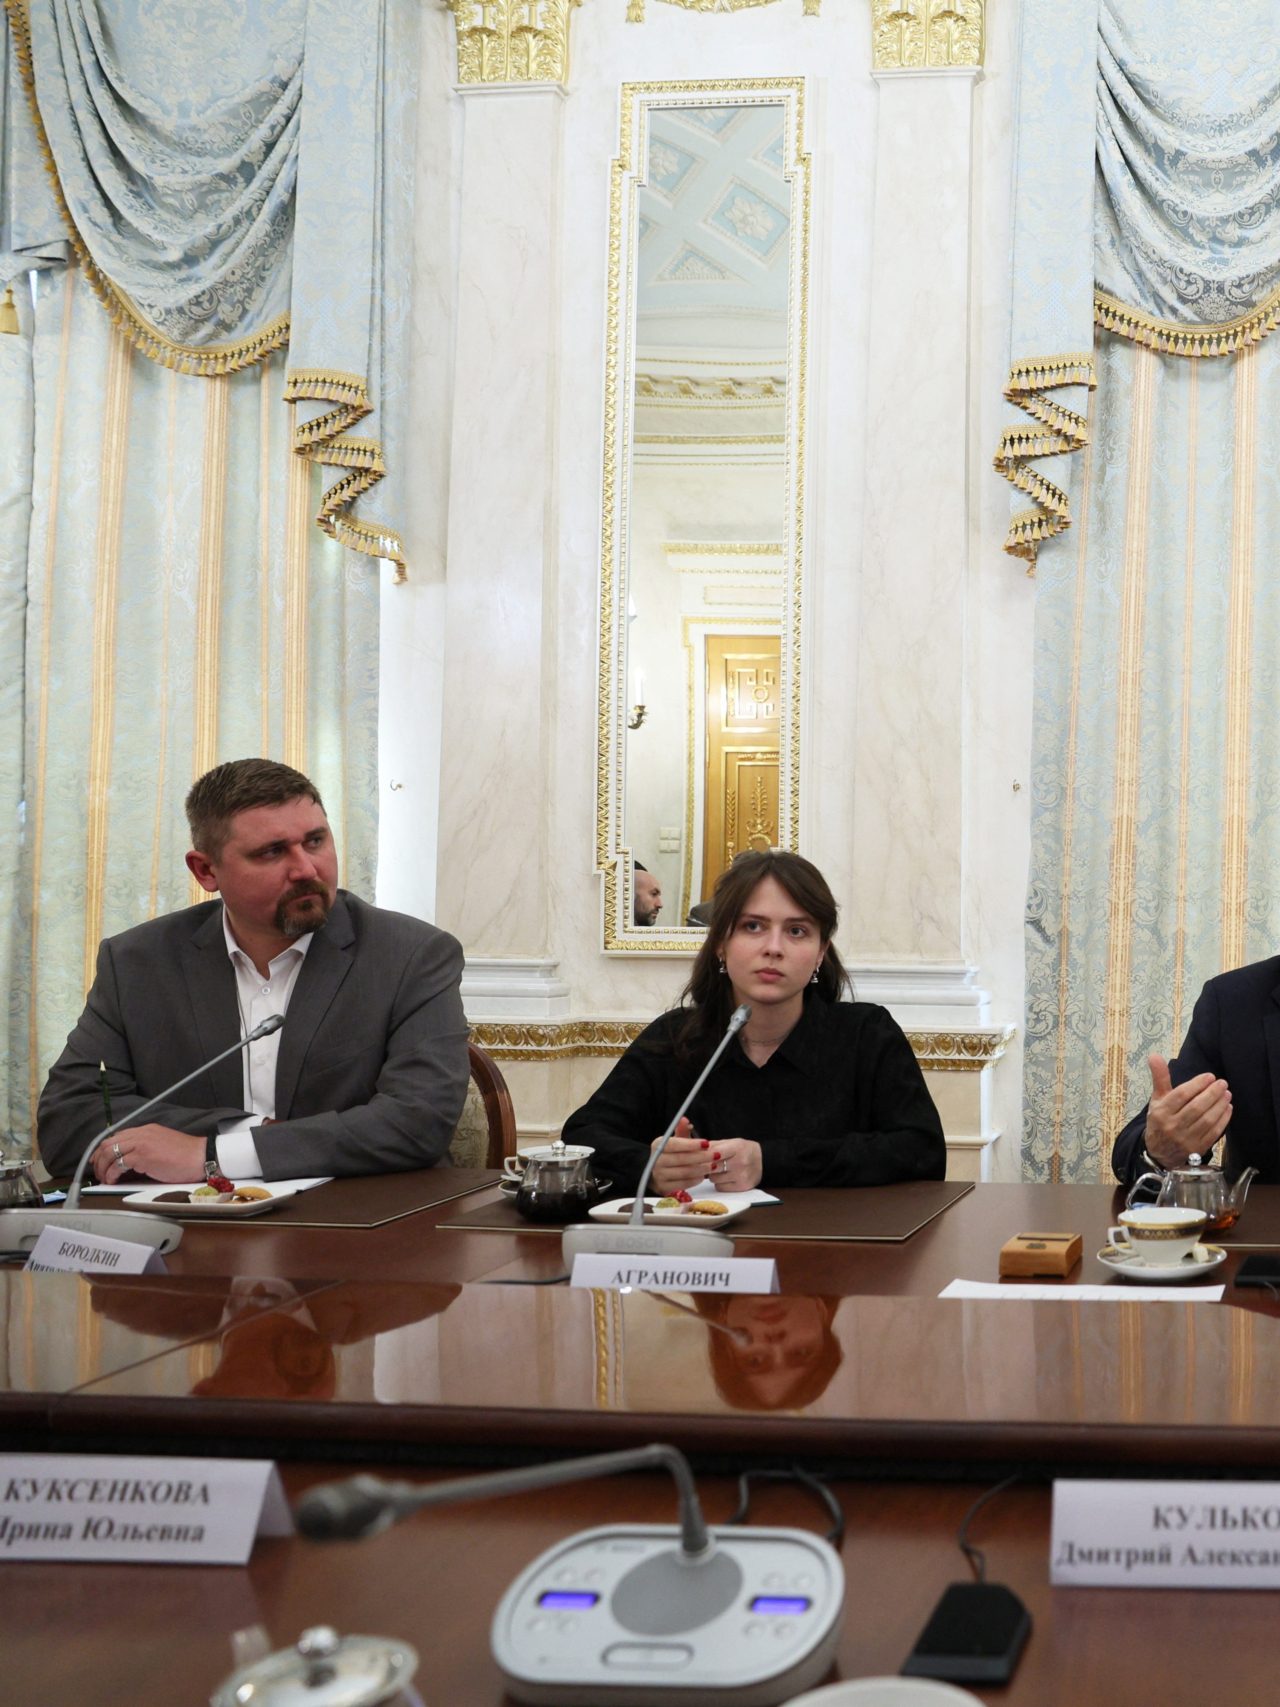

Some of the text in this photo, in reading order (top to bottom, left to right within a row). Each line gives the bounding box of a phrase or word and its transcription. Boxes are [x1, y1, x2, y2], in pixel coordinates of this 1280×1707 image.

[58, 1241, 121, 1268] БОРОДКИН
[611, 1269, 731, 1287] АГРАНОВИЧ
[4, 1477, 210, 1504] КУКСЕНКОВА
[81, 1517, 206, 1543] Юльевна
[1055, 1540, 1171, 1572] Дмитрий
